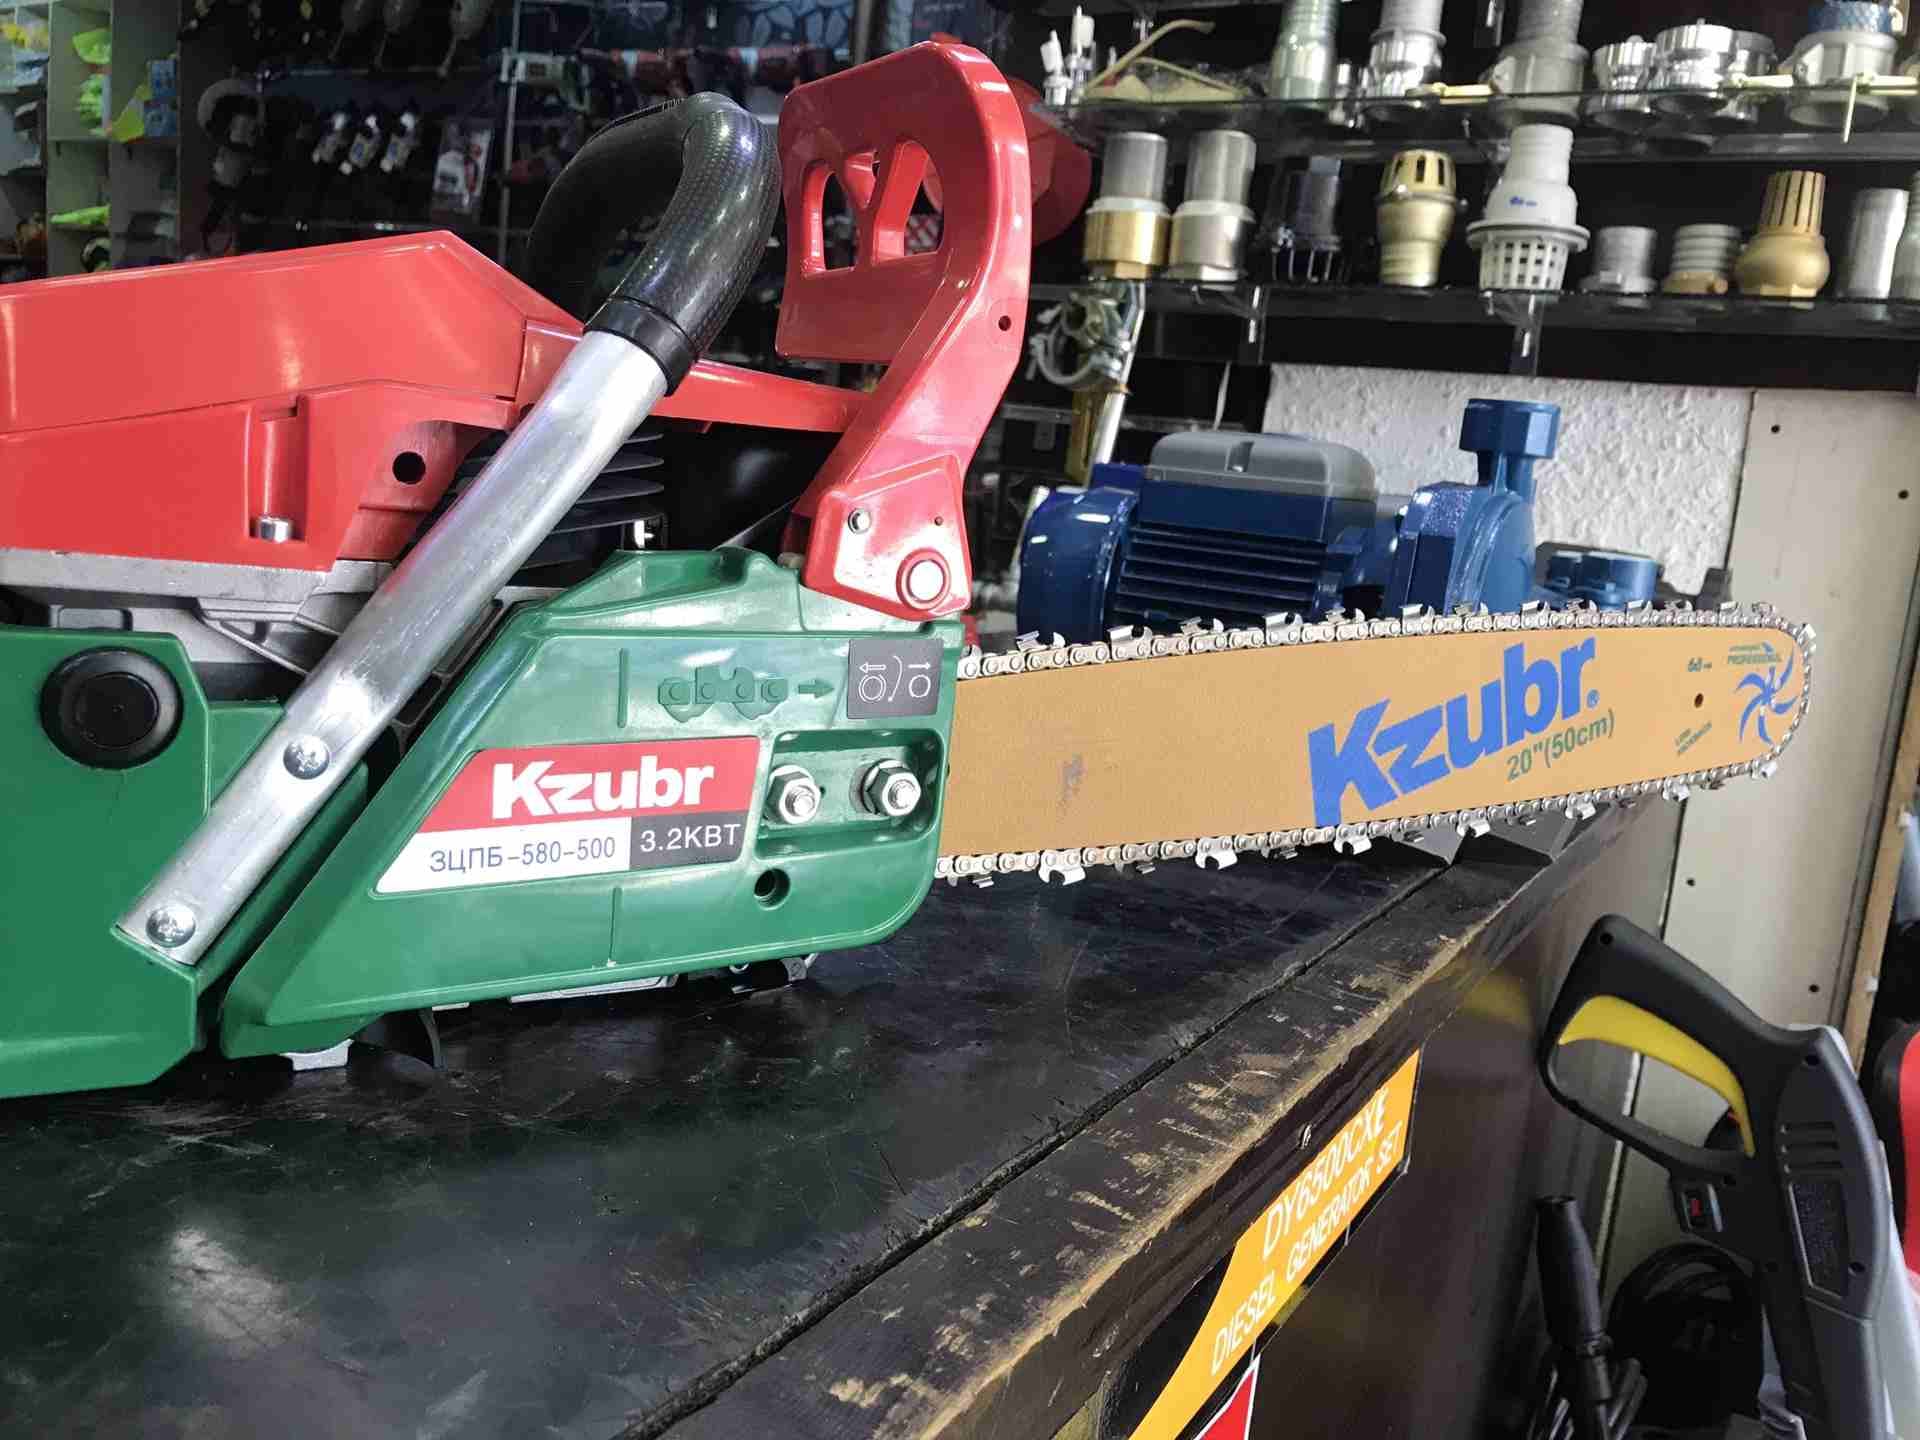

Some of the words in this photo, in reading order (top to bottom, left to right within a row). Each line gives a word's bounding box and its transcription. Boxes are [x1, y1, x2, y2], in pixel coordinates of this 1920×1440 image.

[492, 755, 714, 819] Kzubr
[1210, 1269, 1277, 1376] DIESEL
[1286, 1156, 1375, 1282] GENERATOR
